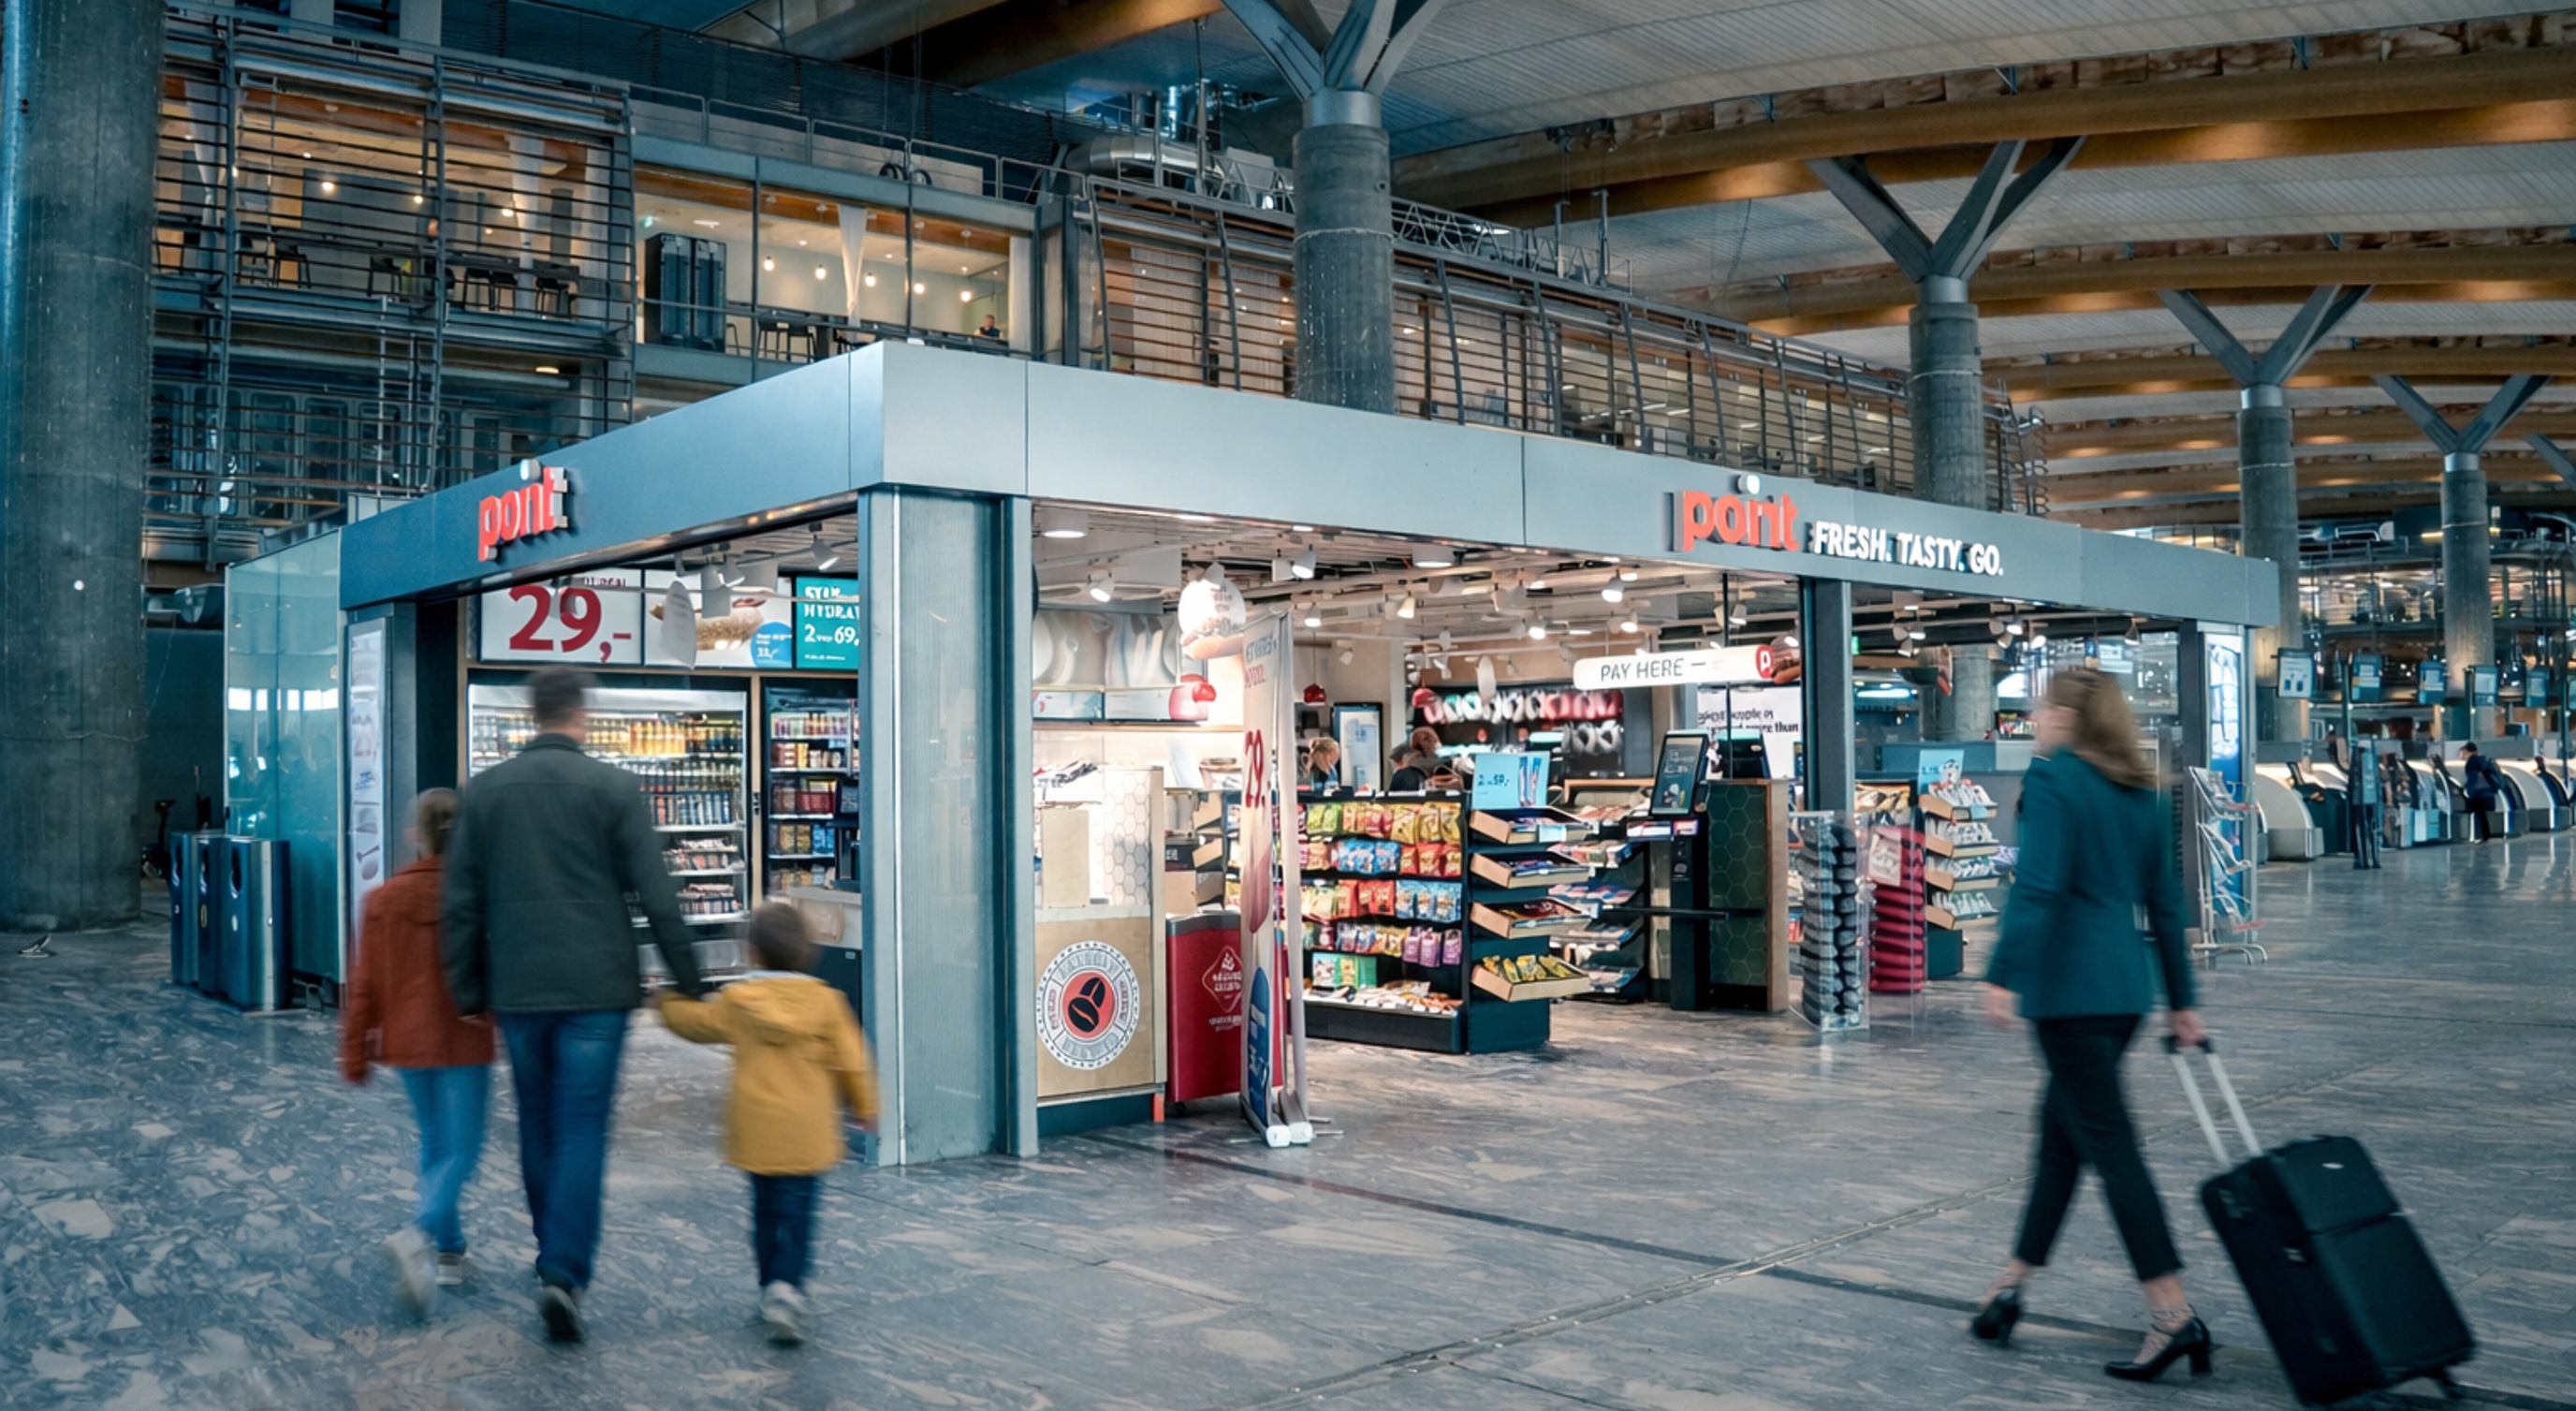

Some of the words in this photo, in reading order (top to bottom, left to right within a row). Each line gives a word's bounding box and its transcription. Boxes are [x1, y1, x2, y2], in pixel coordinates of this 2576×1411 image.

[1680, 474, 1800, 551] point
[1814, 521, 1891, 562] FRESH.
[1898, 532, 1966, 572] TASTY.
[1969, 544, 2004, 576] GO.
[1601, 662, 1632, 683] PAY
[1636, 657, 1685, 680] HERE
